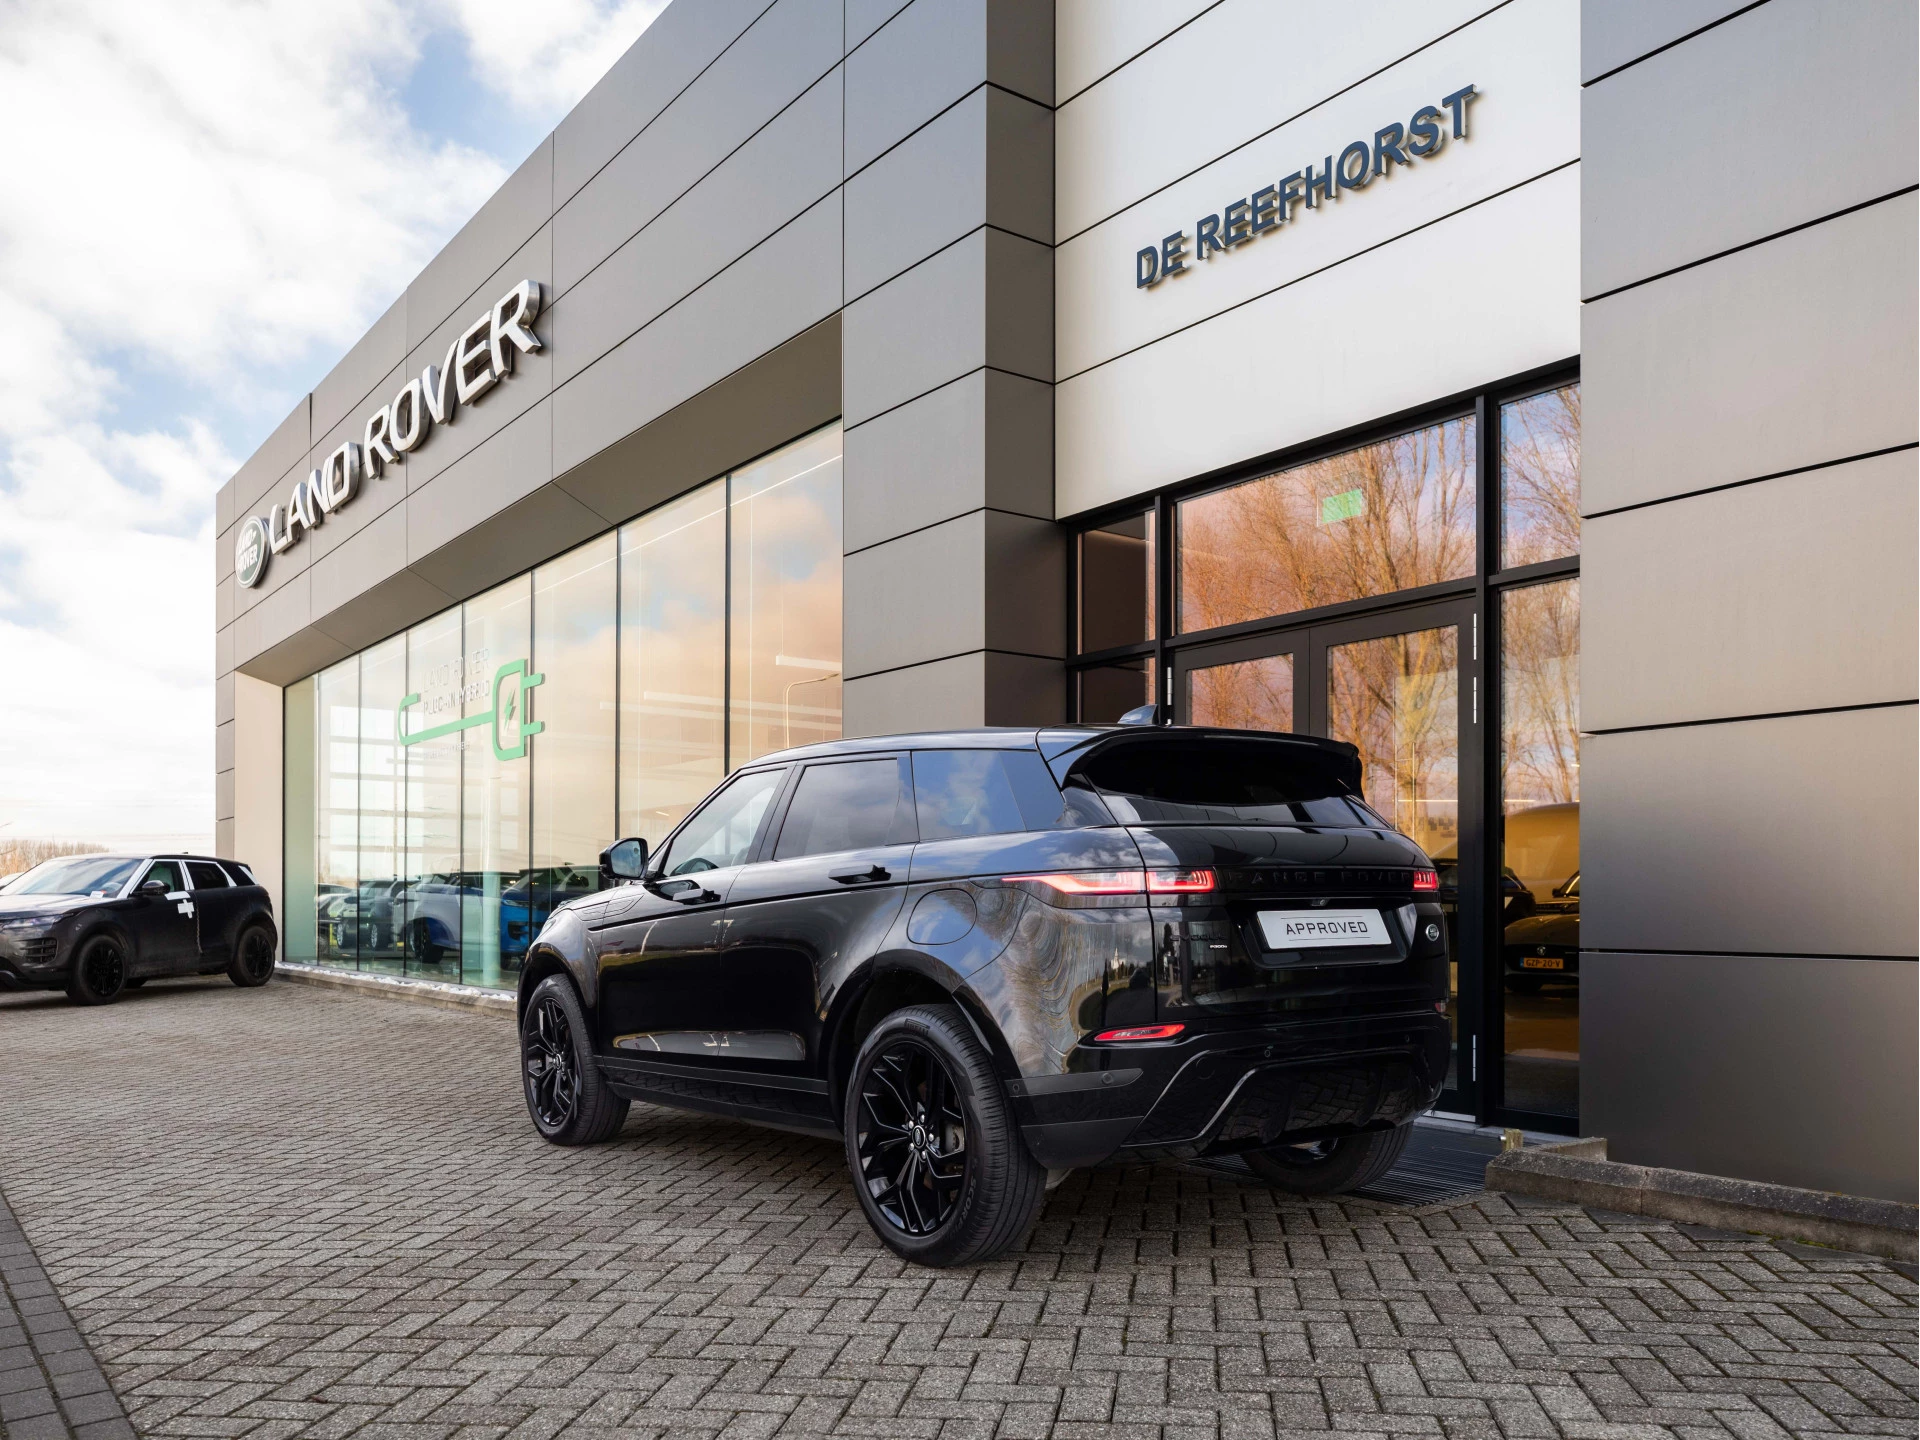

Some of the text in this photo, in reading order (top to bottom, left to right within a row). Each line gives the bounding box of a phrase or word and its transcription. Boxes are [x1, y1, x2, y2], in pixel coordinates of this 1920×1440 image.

[1136, 83, 1478, 289] DE REEFHORST
[268, 279, 542, 555] LAND ROVER
[423, 690, 456, 716] PLUG-IN
[1227, 869, 1411, 885] RANGE ROVER
[1285, 921, 1369, 936] APPROVED
[1525, 958, 1561, 968] GZP-20-V
